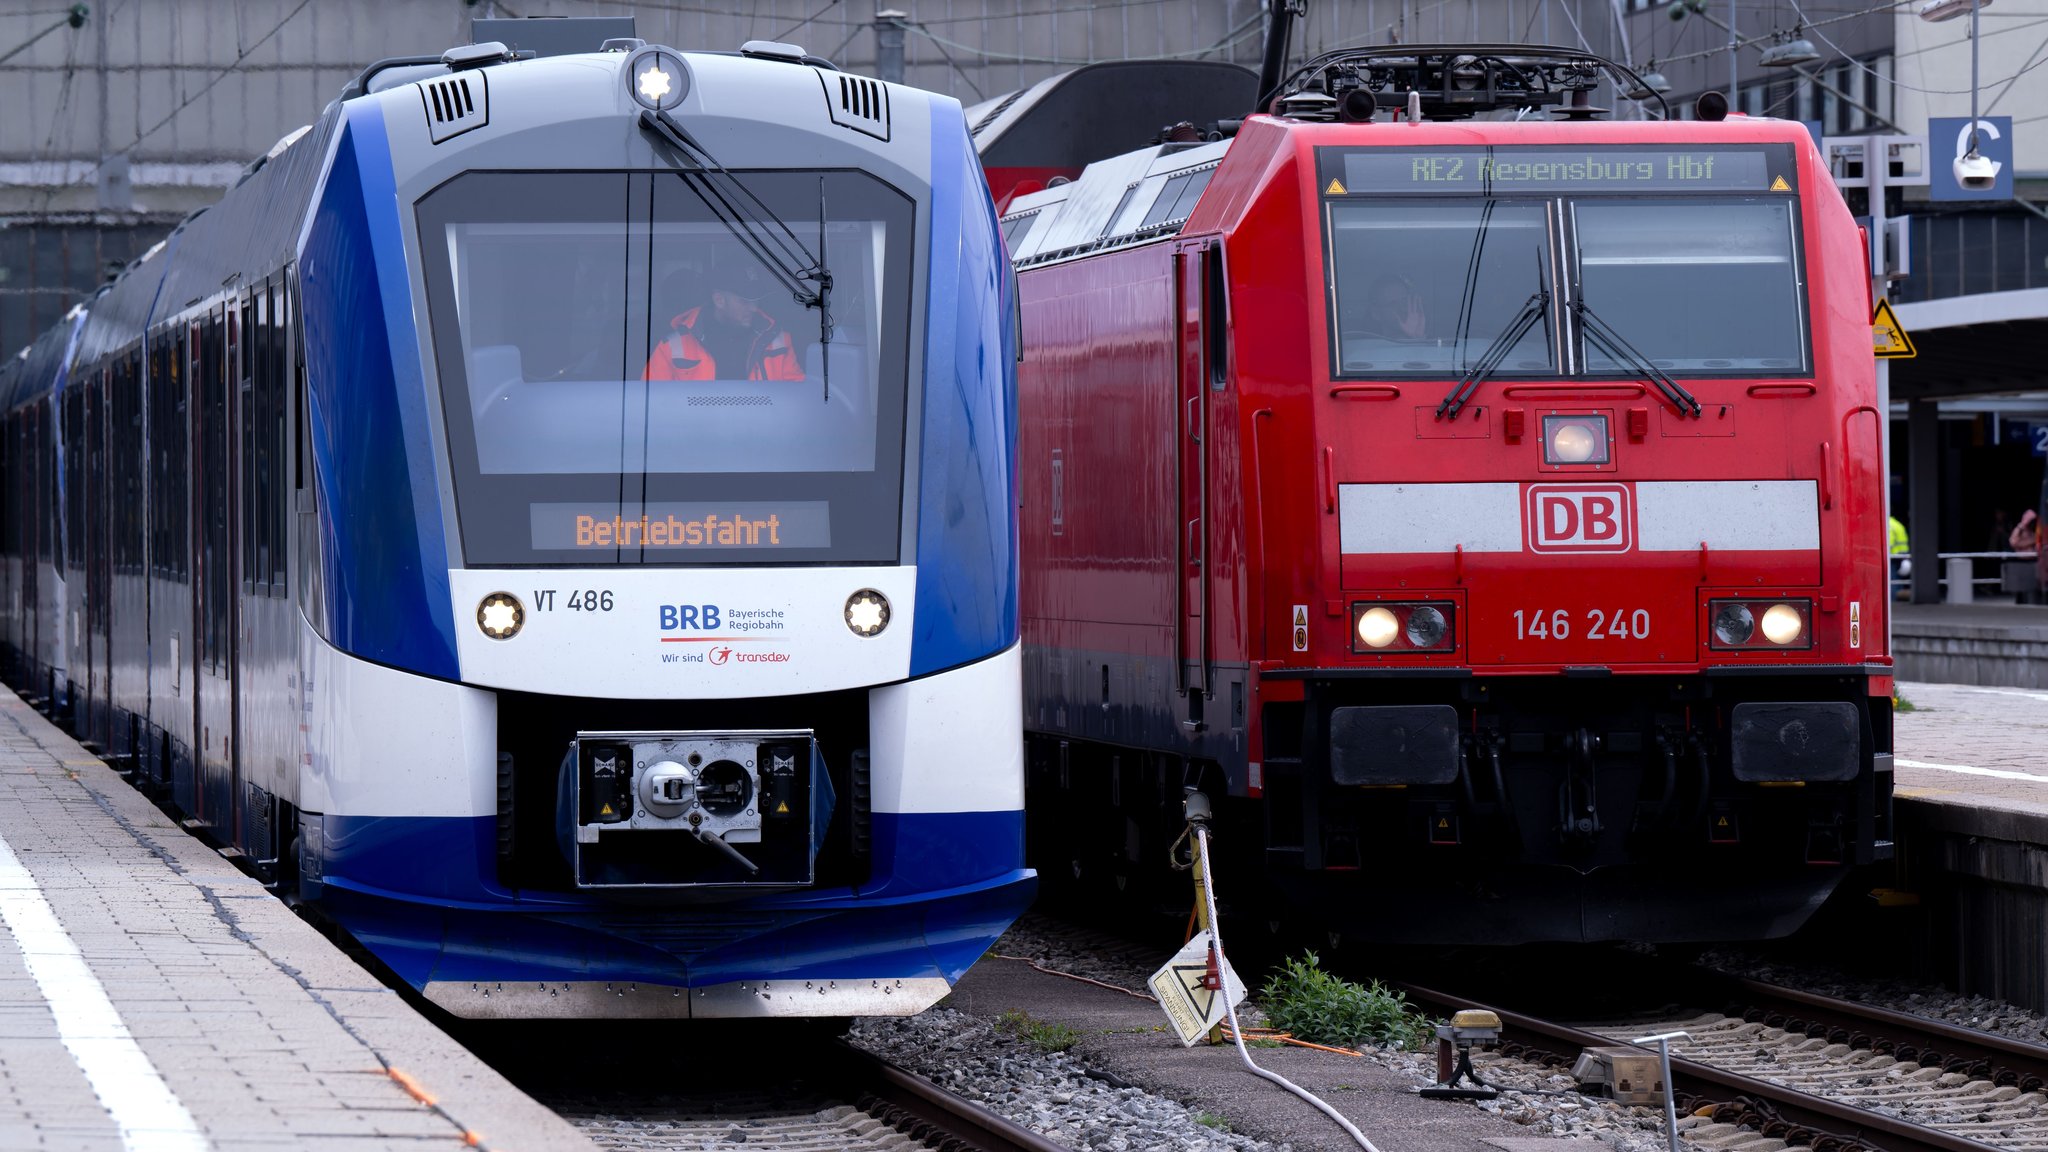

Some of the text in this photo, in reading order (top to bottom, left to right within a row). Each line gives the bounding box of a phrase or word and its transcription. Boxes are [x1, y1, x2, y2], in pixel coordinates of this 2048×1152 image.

[1411, 155, 1715, 182] RE2 Regensburg Hbf
[576, 514, 780, 546] Betriebsfahrt
[1542, 496, 1618, 541] DB
[534, 589, 614, 612] VT 486
[659, 604, 721, 630] BRB
[728, 608, 785, 620] Bayerische
[728, 620, 785, 631] Regiobahn
[1513, 608, 1650, 640] 146 240
[661, 652, 791, 663] Wir sind transdev
[1160, 985, 1189, 1032] SPANNUNG!
